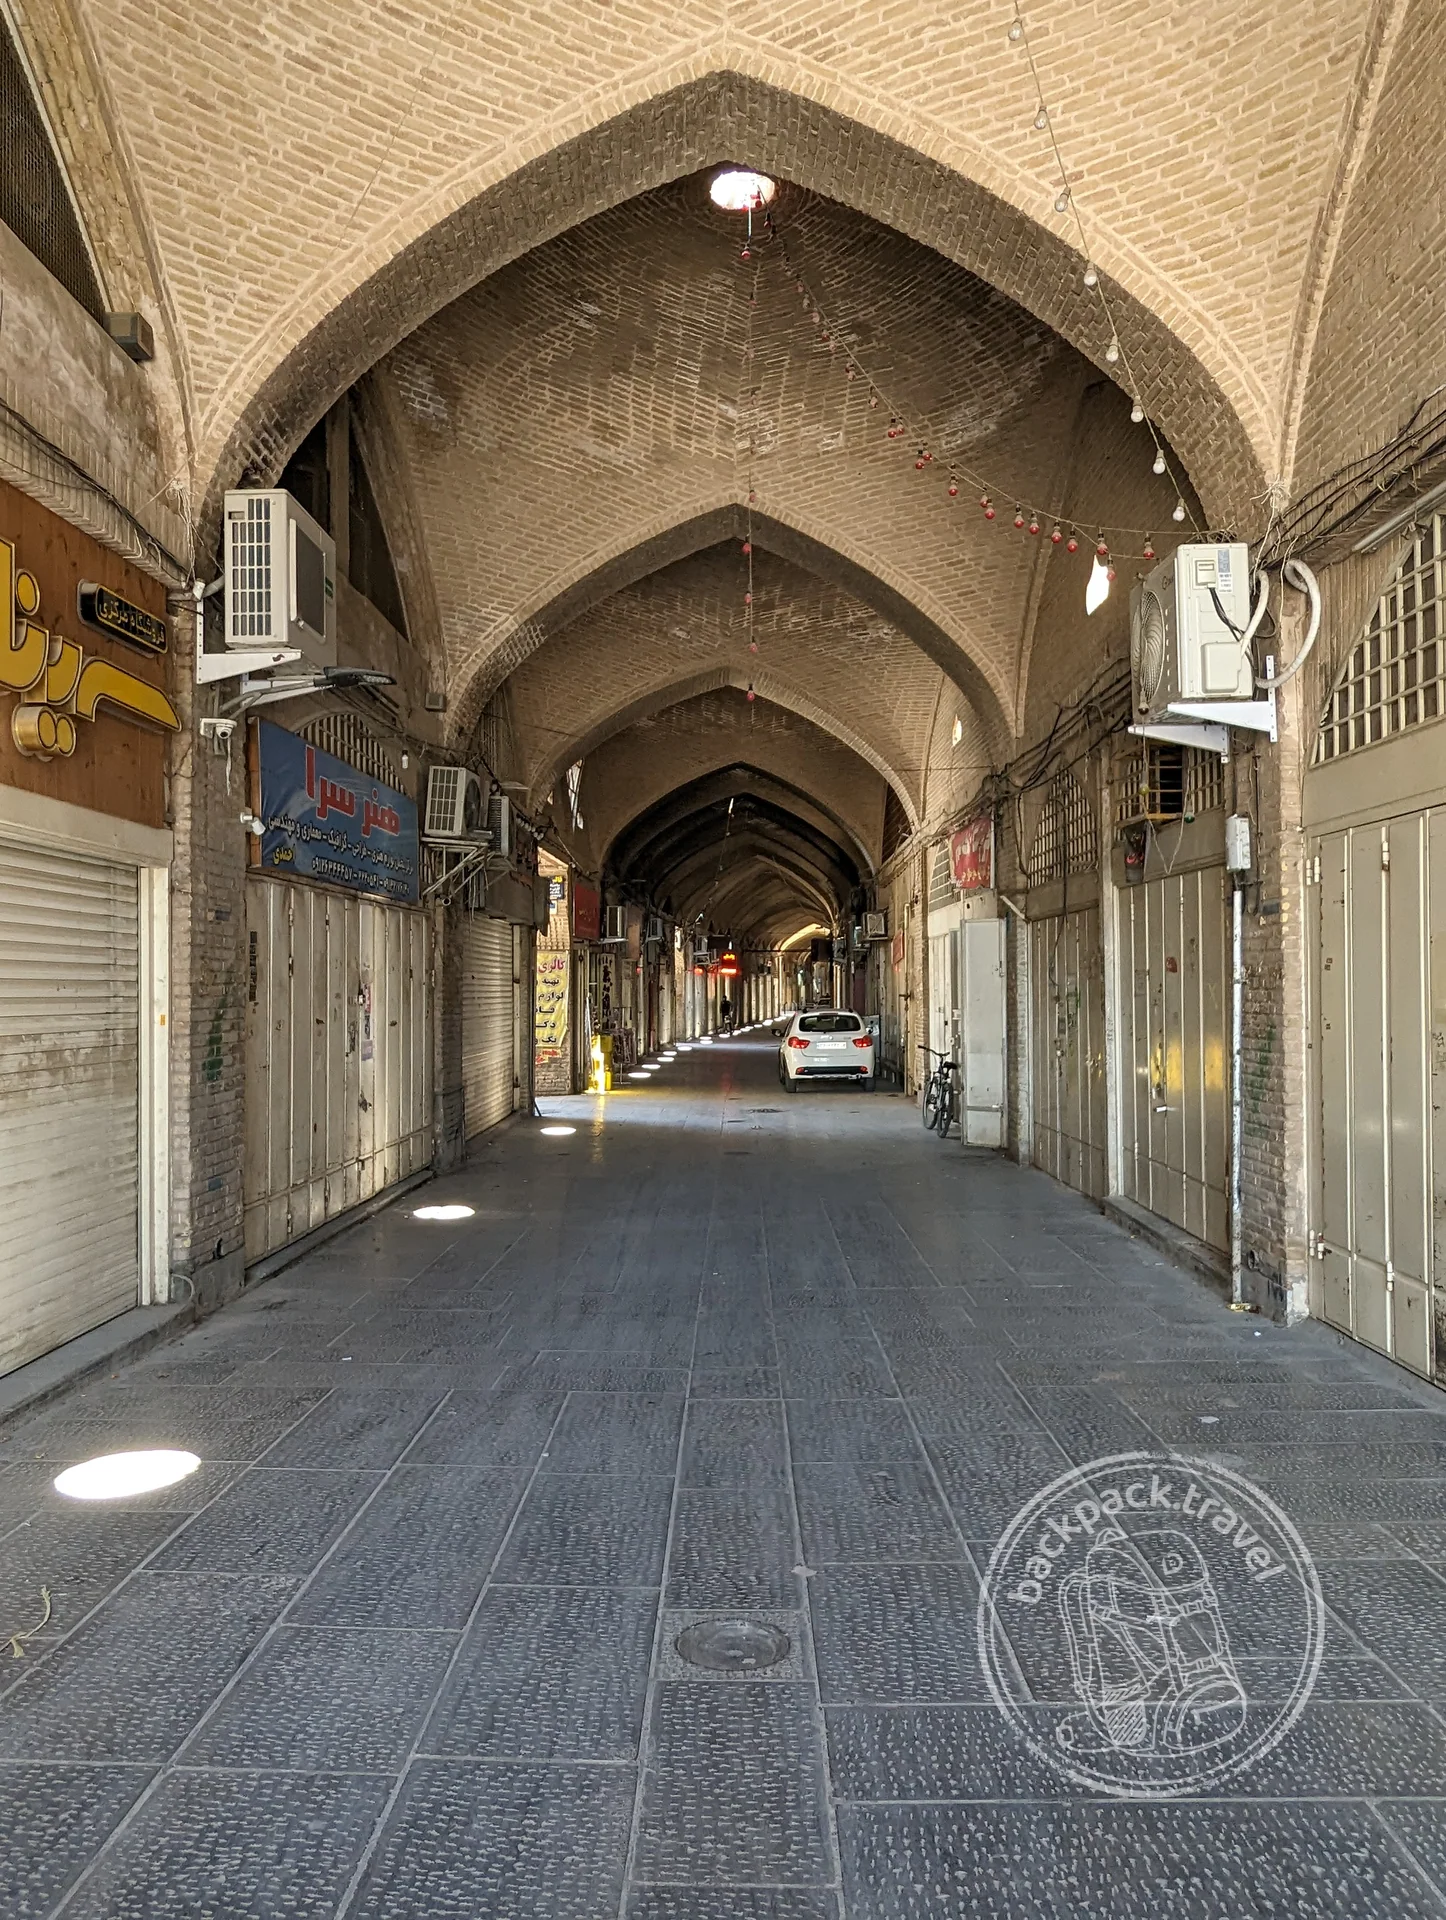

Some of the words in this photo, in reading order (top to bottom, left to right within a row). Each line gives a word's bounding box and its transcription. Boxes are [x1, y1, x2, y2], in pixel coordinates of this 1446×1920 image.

[99, 600, 129, 625] مرکزی
[130, 612, 165, 645] فروشگاه
[305, 743, 356, 821] سرا
[268, 812, 296, 837] مهندسی
[361, 787, 401, 838] هنر
[295, 824, 302, 839] و
[301, 821, 322, 842] معماری
[327, 827, 348, 853] گرافیک
[351, 841, 367, 860] طراحی
[538, 990, 564, 1002] لوازم
